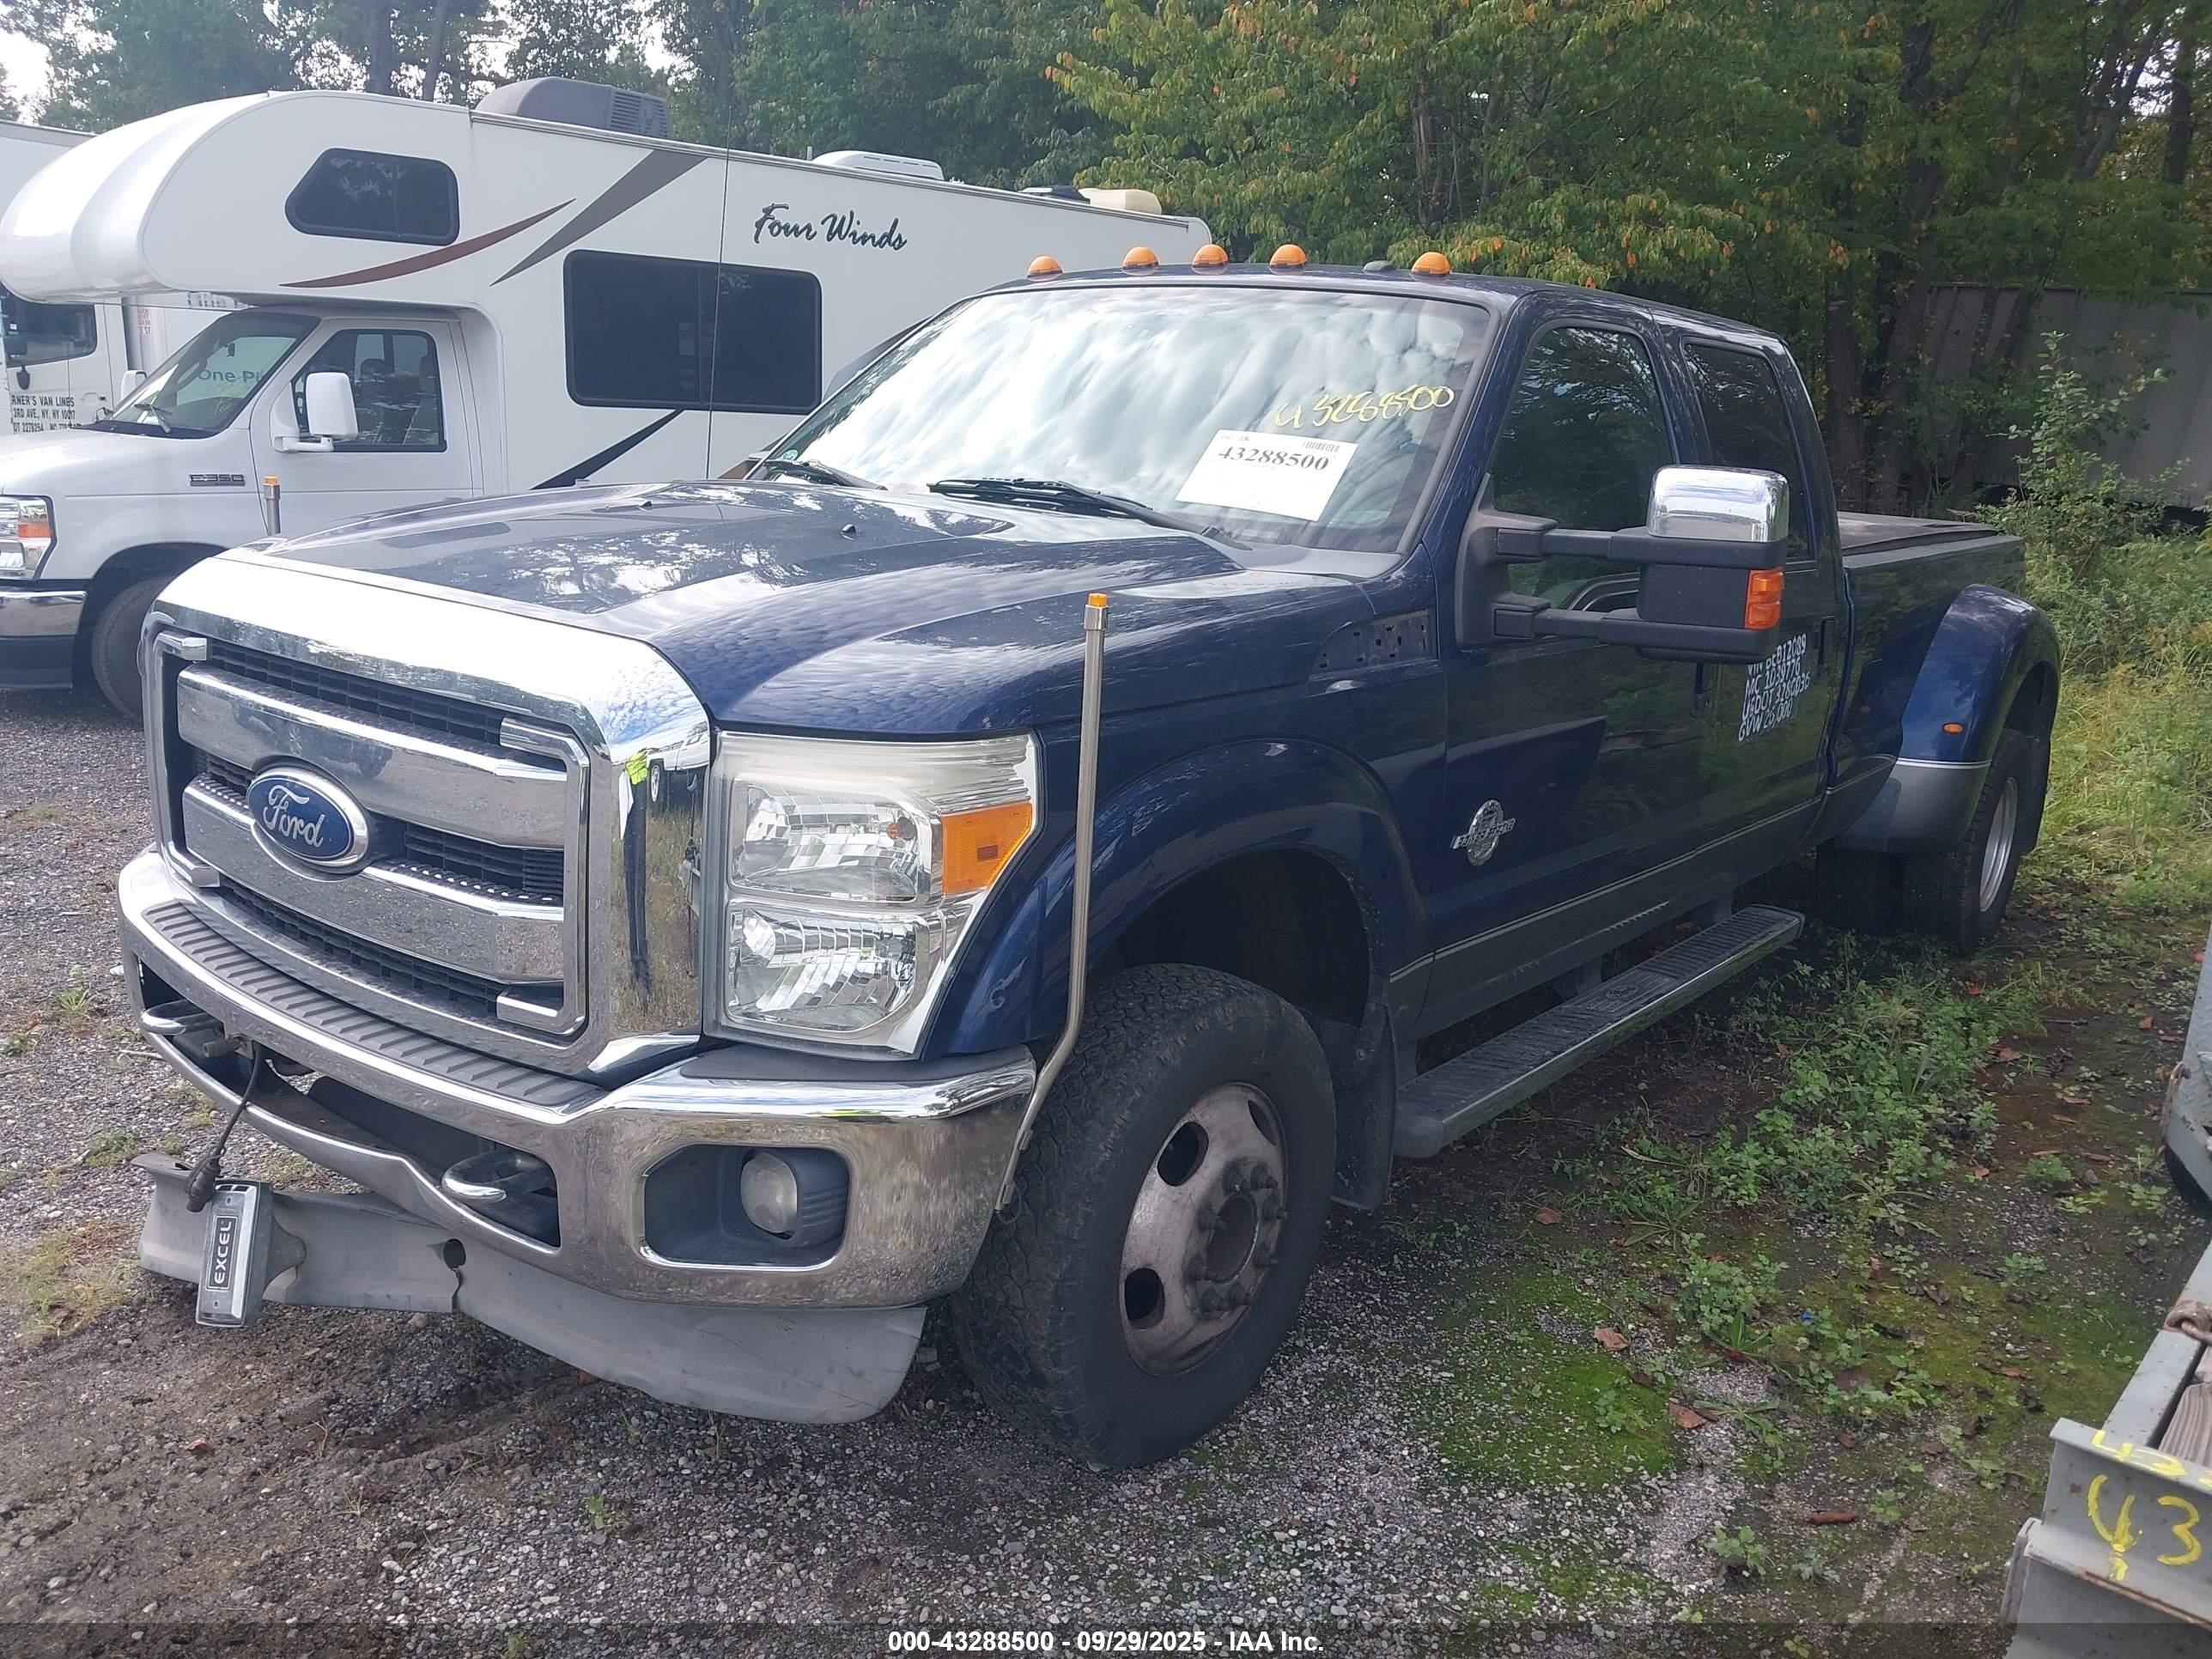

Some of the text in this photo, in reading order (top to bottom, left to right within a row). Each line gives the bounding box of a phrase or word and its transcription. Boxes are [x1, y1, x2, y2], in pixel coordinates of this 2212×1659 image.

[753, 203, 908, 251] Four Winds
[198, 369, 235, 383] One
[13, 407, 24, 418] 3RD
[52, 410, 60, 420] NY
[40, 396, 52, 407] VAN
[55, 397, 75, 407] LINES
[1218, 446, 1330, 471] 43288500
[1742, 689, 1774, 721] USDOT
[1738, 712, 1764, 742] GVW
[262, 784, 326, 848] Ford
[214, 1220, 233, 1285] EXCEL
